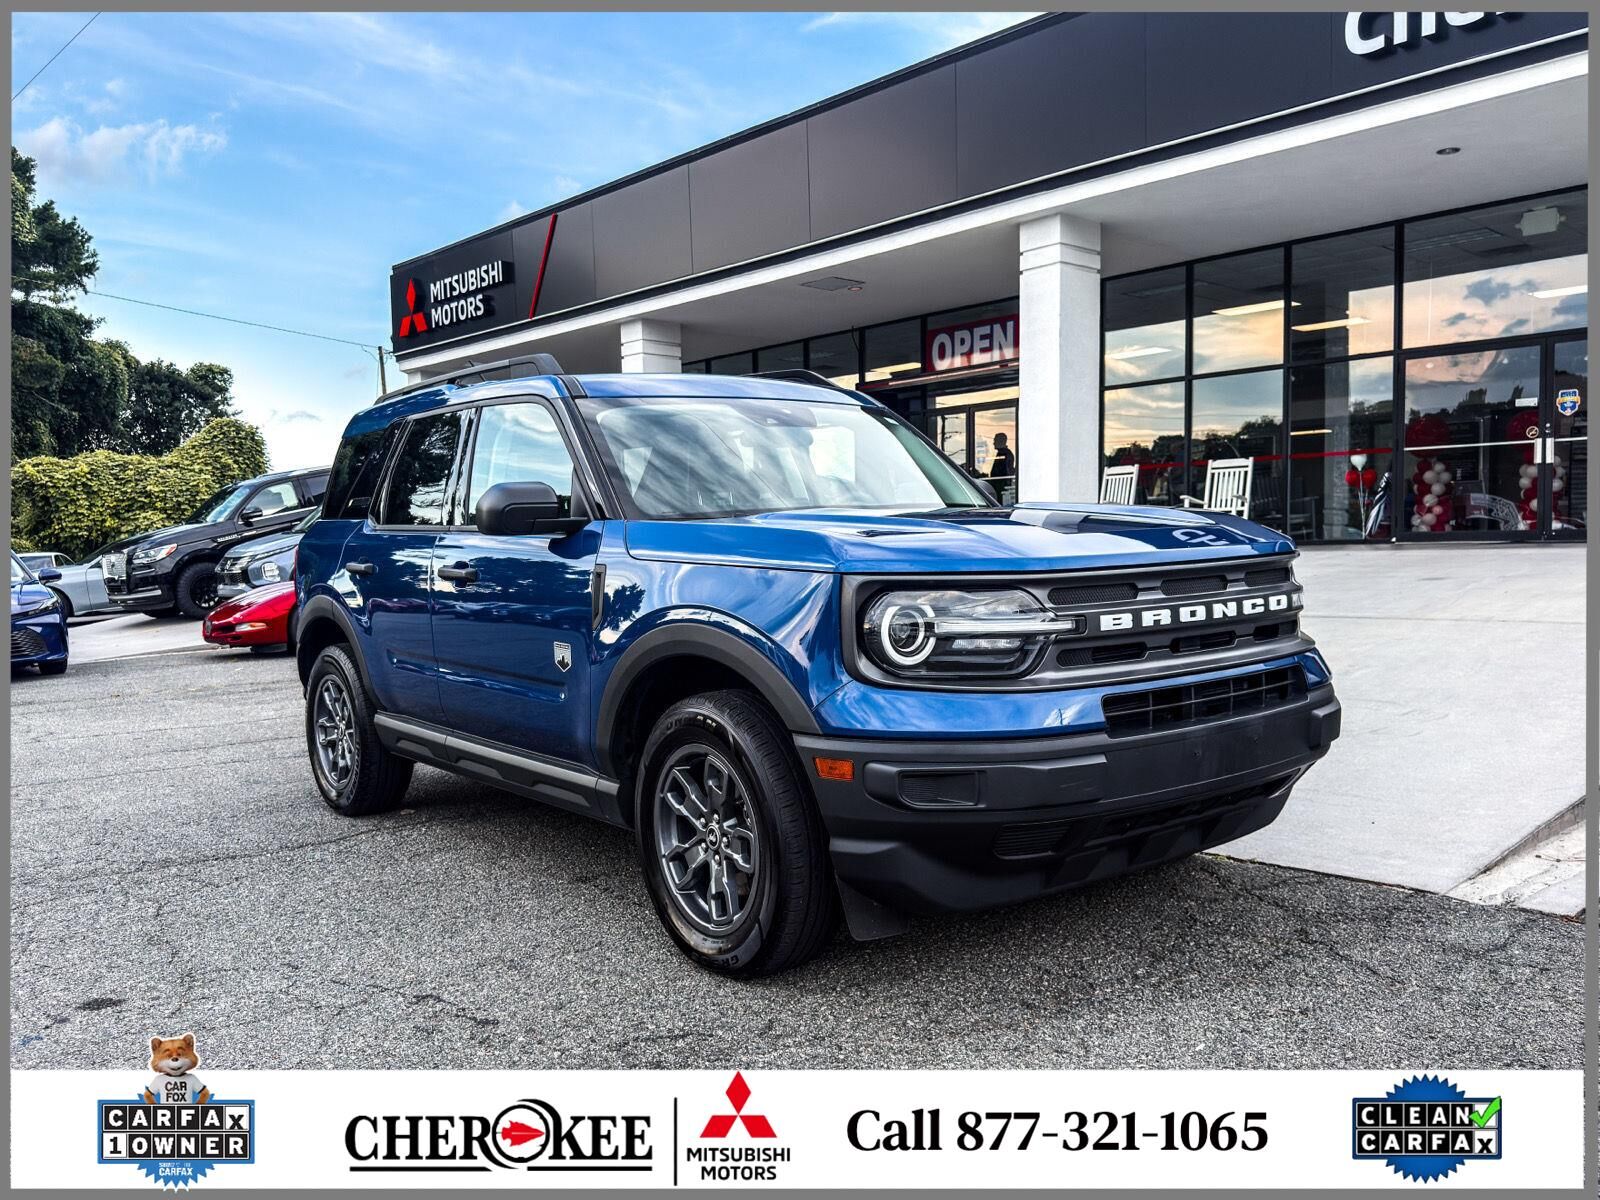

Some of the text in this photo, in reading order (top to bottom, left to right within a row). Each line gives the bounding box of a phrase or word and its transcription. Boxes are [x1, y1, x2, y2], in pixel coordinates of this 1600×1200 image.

[430, 260, 503, 303] MITSUBISHI
[431, 294, 485, 328] MOTORS
[932, 320, 1015, 371] OPEN
[1100, 594, 1288, 632] BRONCO
